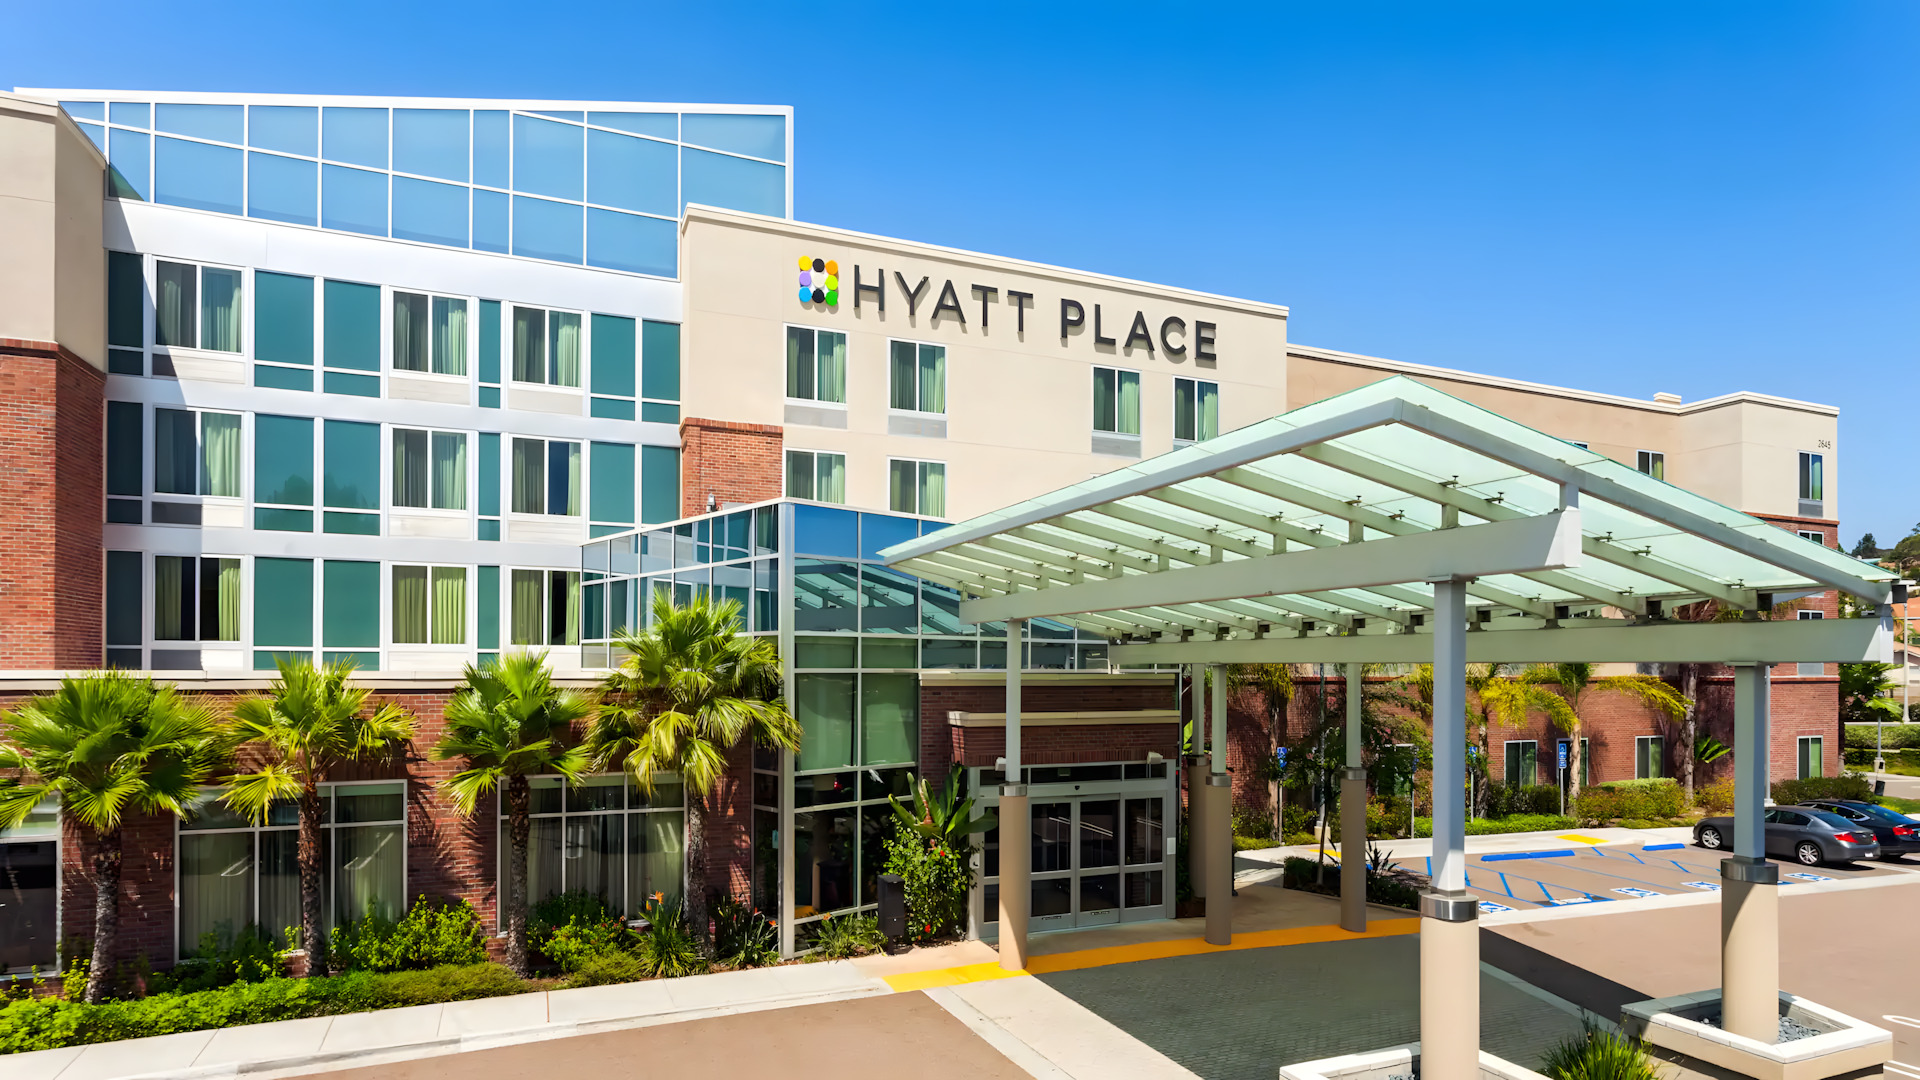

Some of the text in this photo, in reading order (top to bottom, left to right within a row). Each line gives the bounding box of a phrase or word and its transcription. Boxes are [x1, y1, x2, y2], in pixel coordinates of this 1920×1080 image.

[854, 264, 1217, 361] HYATT PLACE
[1817, 439, 1831, 450] 2645
